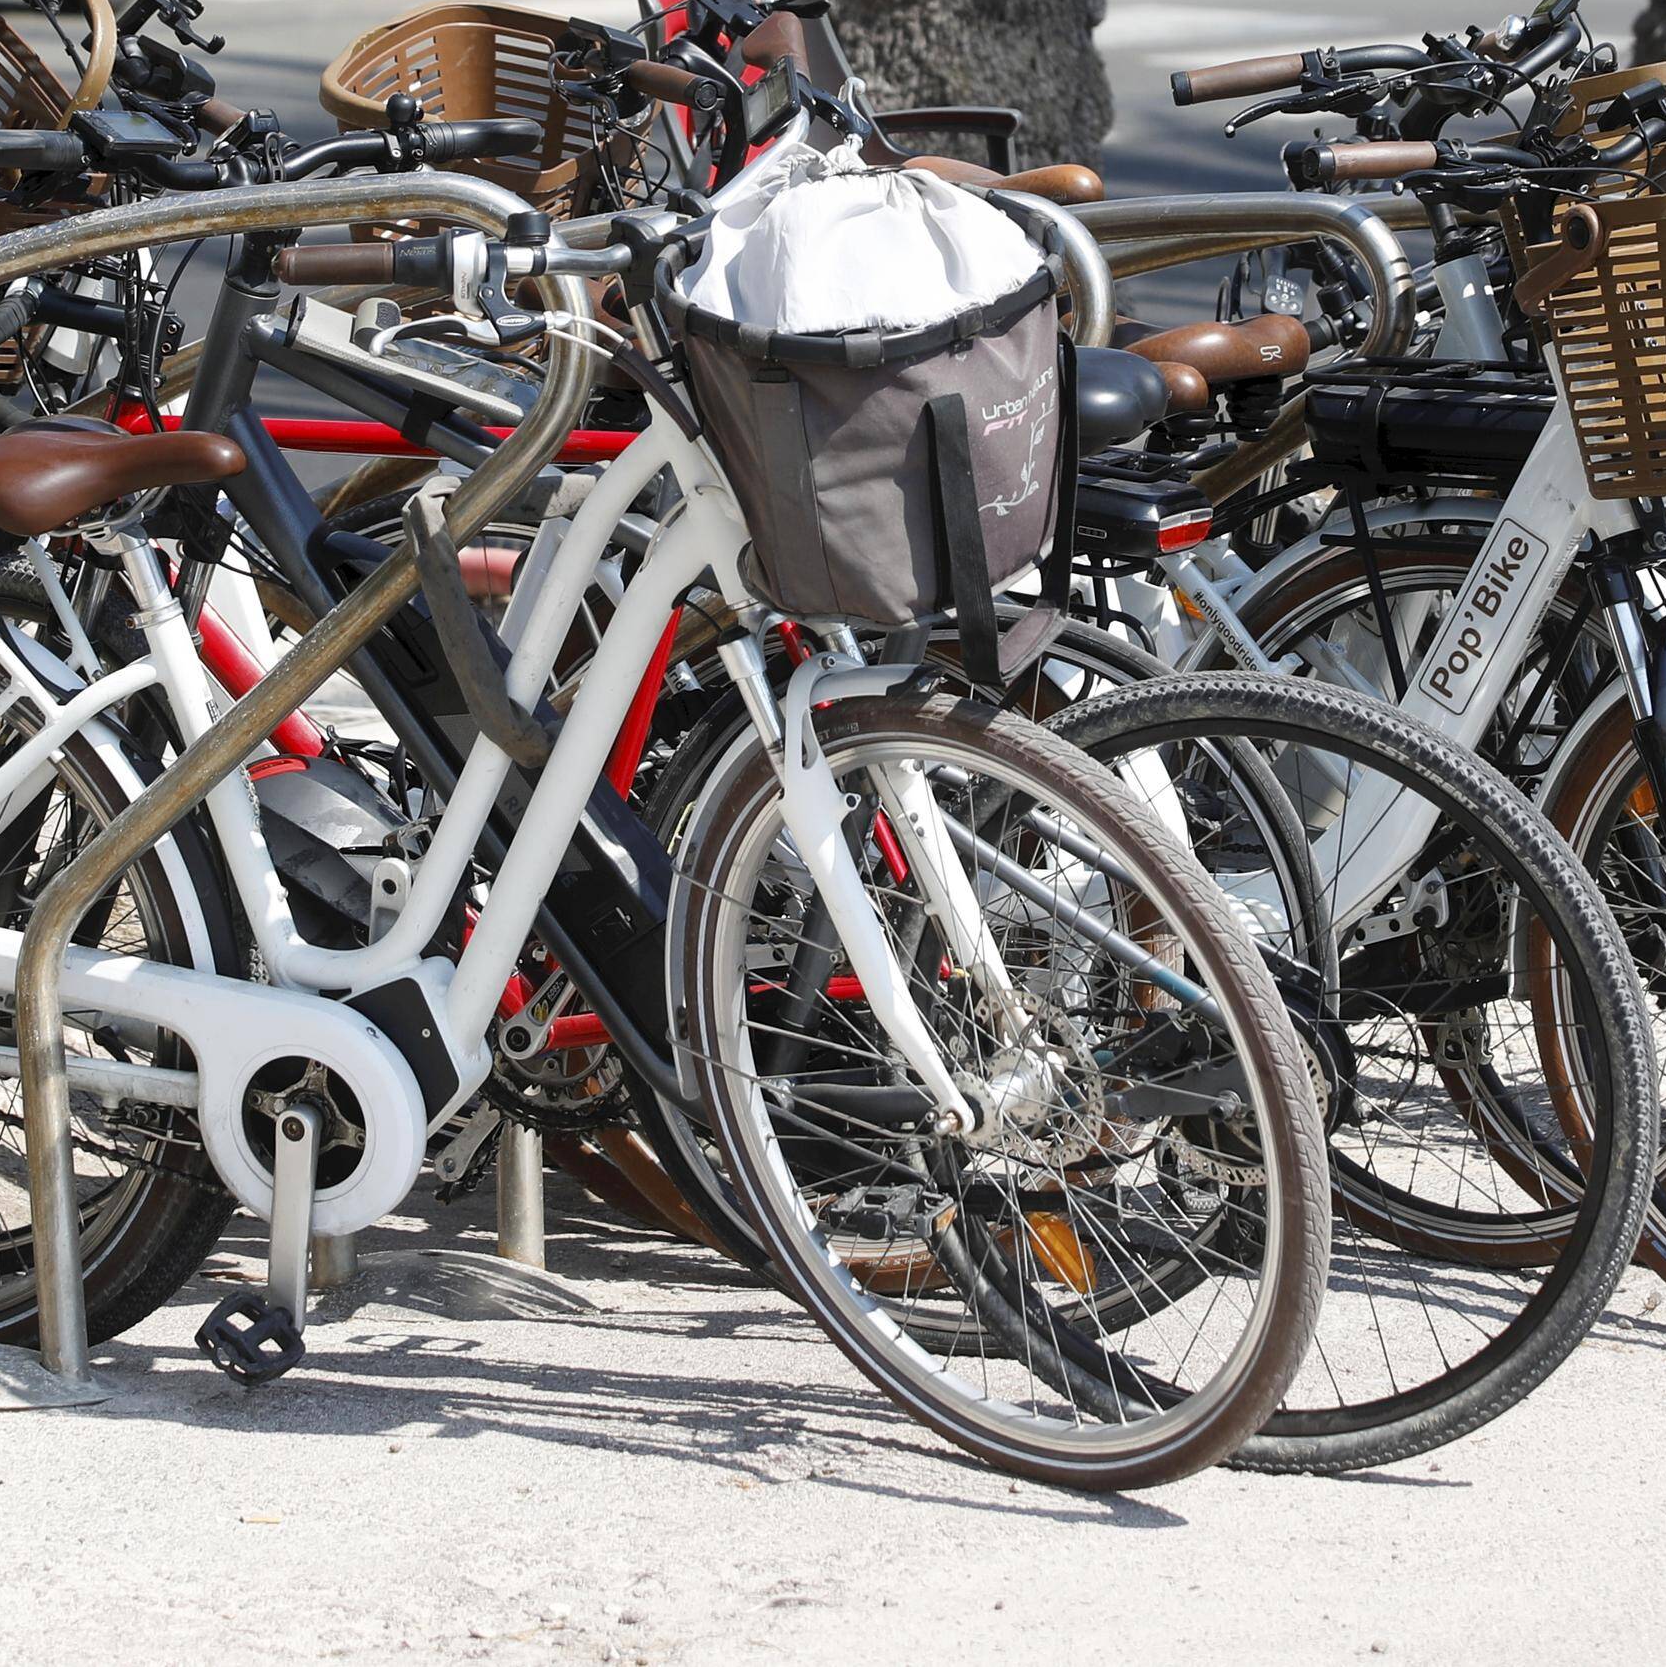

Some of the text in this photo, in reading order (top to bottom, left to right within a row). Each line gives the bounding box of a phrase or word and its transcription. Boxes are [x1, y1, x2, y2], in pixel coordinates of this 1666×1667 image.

[1259, 344, 1283, 362] SR
[981, 395, 1028, 421] Urban
[1429, 533, 1531, 701] Pop'Bike
[1192, 590, 1261, 672] #onlygoodride
[1371, 739, 1410, 763] CST
